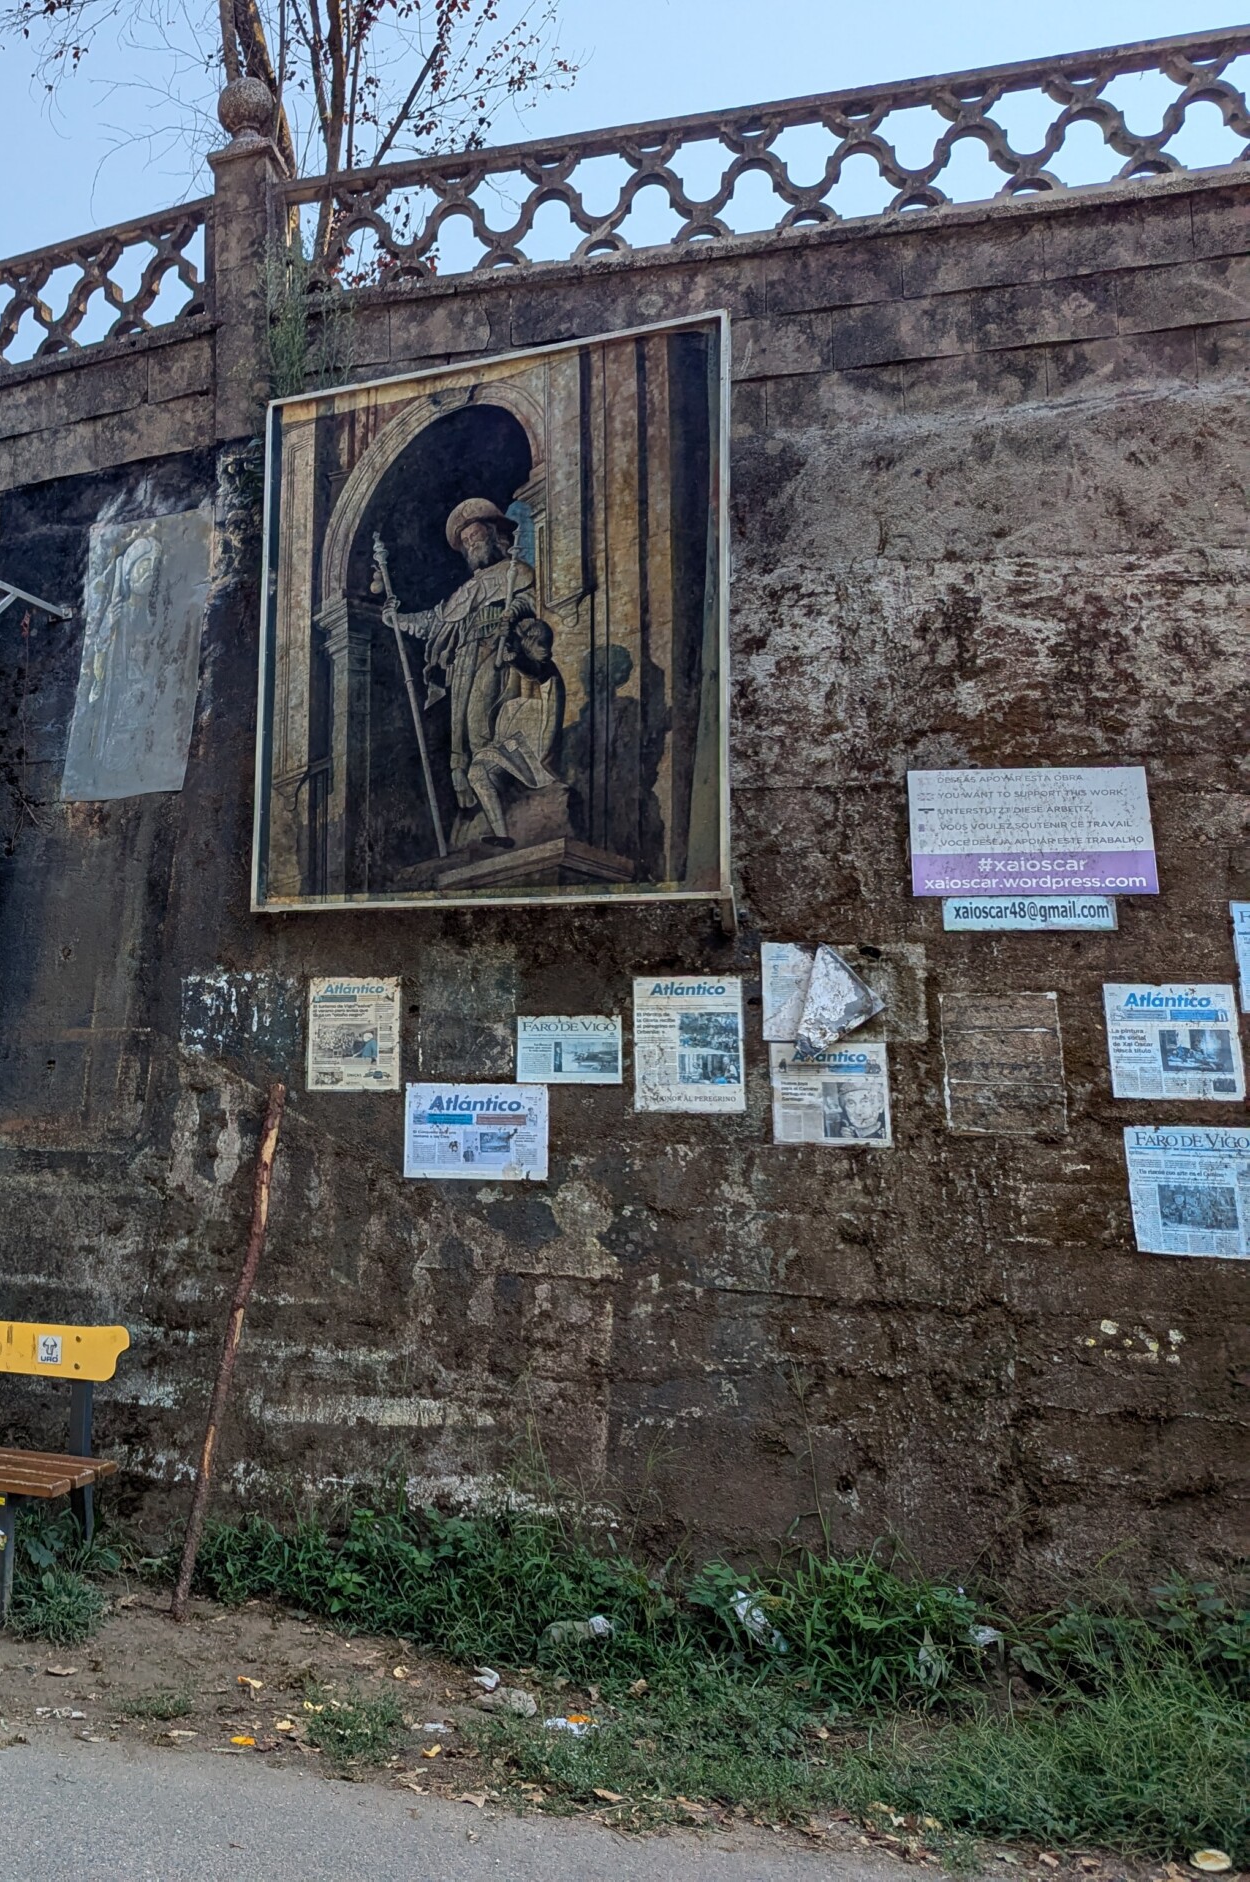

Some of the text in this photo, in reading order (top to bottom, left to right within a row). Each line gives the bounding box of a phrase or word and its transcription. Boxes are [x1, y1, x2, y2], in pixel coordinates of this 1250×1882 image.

[937, 774, 1083, 784] DESEAS APOYAR ESTA OBRA
[964, 791, 994, 799] WANT
[1014, 790, 1061, 798] SUPPORT
[1065, 789, 1087, 797] THIS
[1013, 806, 1043, 814] DIESE
[940, 823, 967, 831] VOUS
[971, 822, 1013, 830] VOULEZ
[1015, 821, 1068, 829] SOUTENIR
[1087, 820, 1133, 828] TRAVAIL
[972, 838, 1012, 846] DESEJA
[1014, 837, 1054, 845] APOIAR
[1058, 837, 1083, 845] ESTE
[1086, 836, 1144, 844] TRABALHO
[978, 857, 1089, 873] #xaioscar
[924, 874, 1147, 890] xaioscar.wordpress.com
[953, 900, 1110, 922] xaioscar48@gmail.com
[324, 983, 385, 994] Atlántico
[650, 981, 726, 996] Atlántico
[1124, 991, 1212, 1008] Atlántico
[522, 1021, 617, 1032] FARO DE VIGO
[428, 1094, 522, 1112] Atlántico
[1134, 1131, 1250, 1149] FARO DE VIGO
